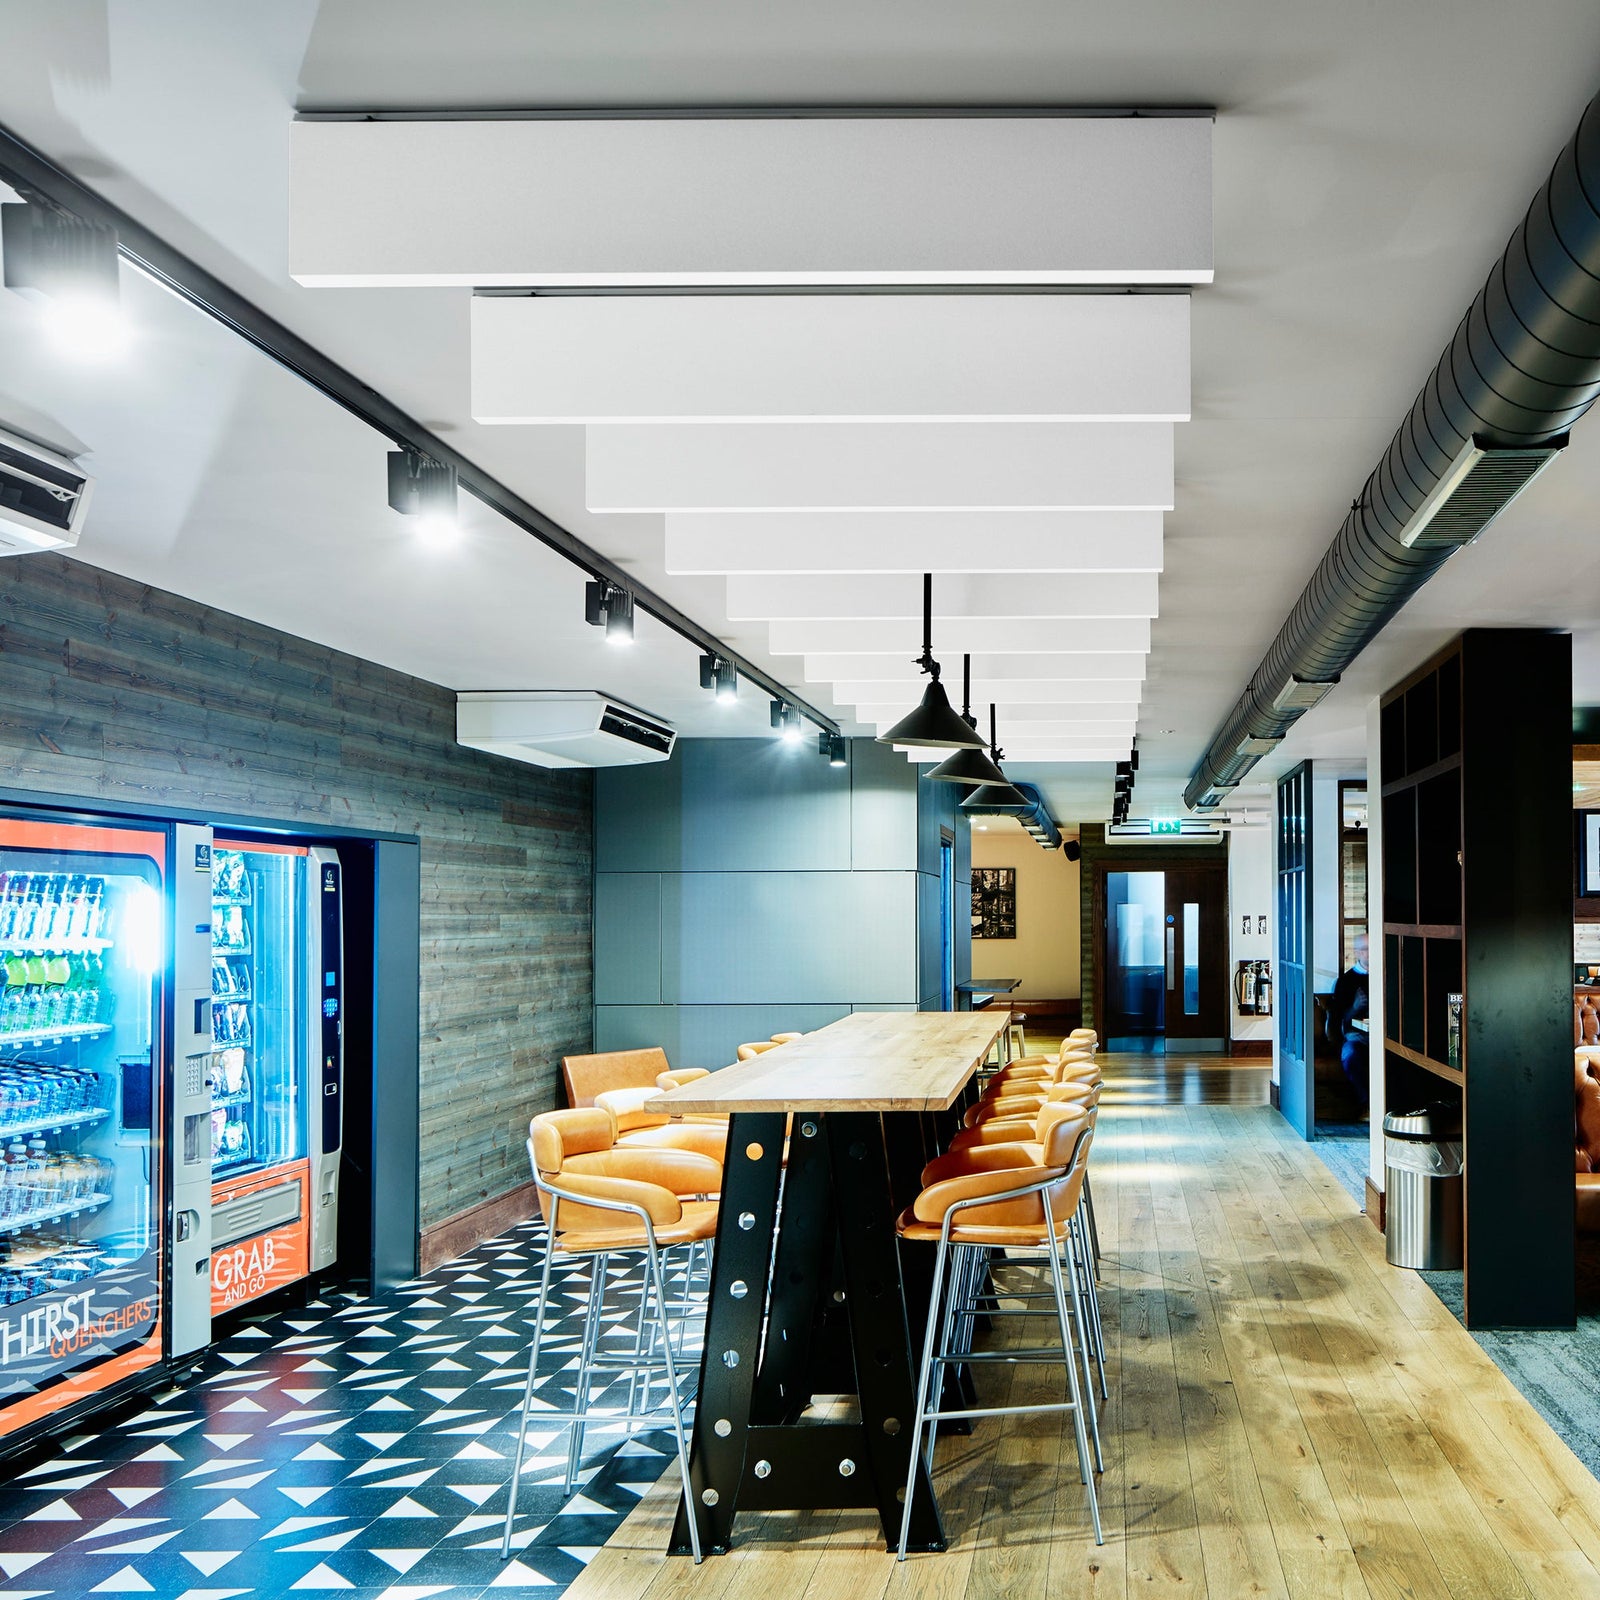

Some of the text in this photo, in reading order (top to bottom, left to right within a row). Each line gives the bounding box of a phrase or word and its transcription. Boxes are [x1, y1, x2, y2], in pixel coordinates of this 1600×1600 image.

[213, 1238, 275, 1291] GRAB
[223, 1274, 266, 1306] AND GO
[51, 1299, 152, 1359] QUENCHERS
